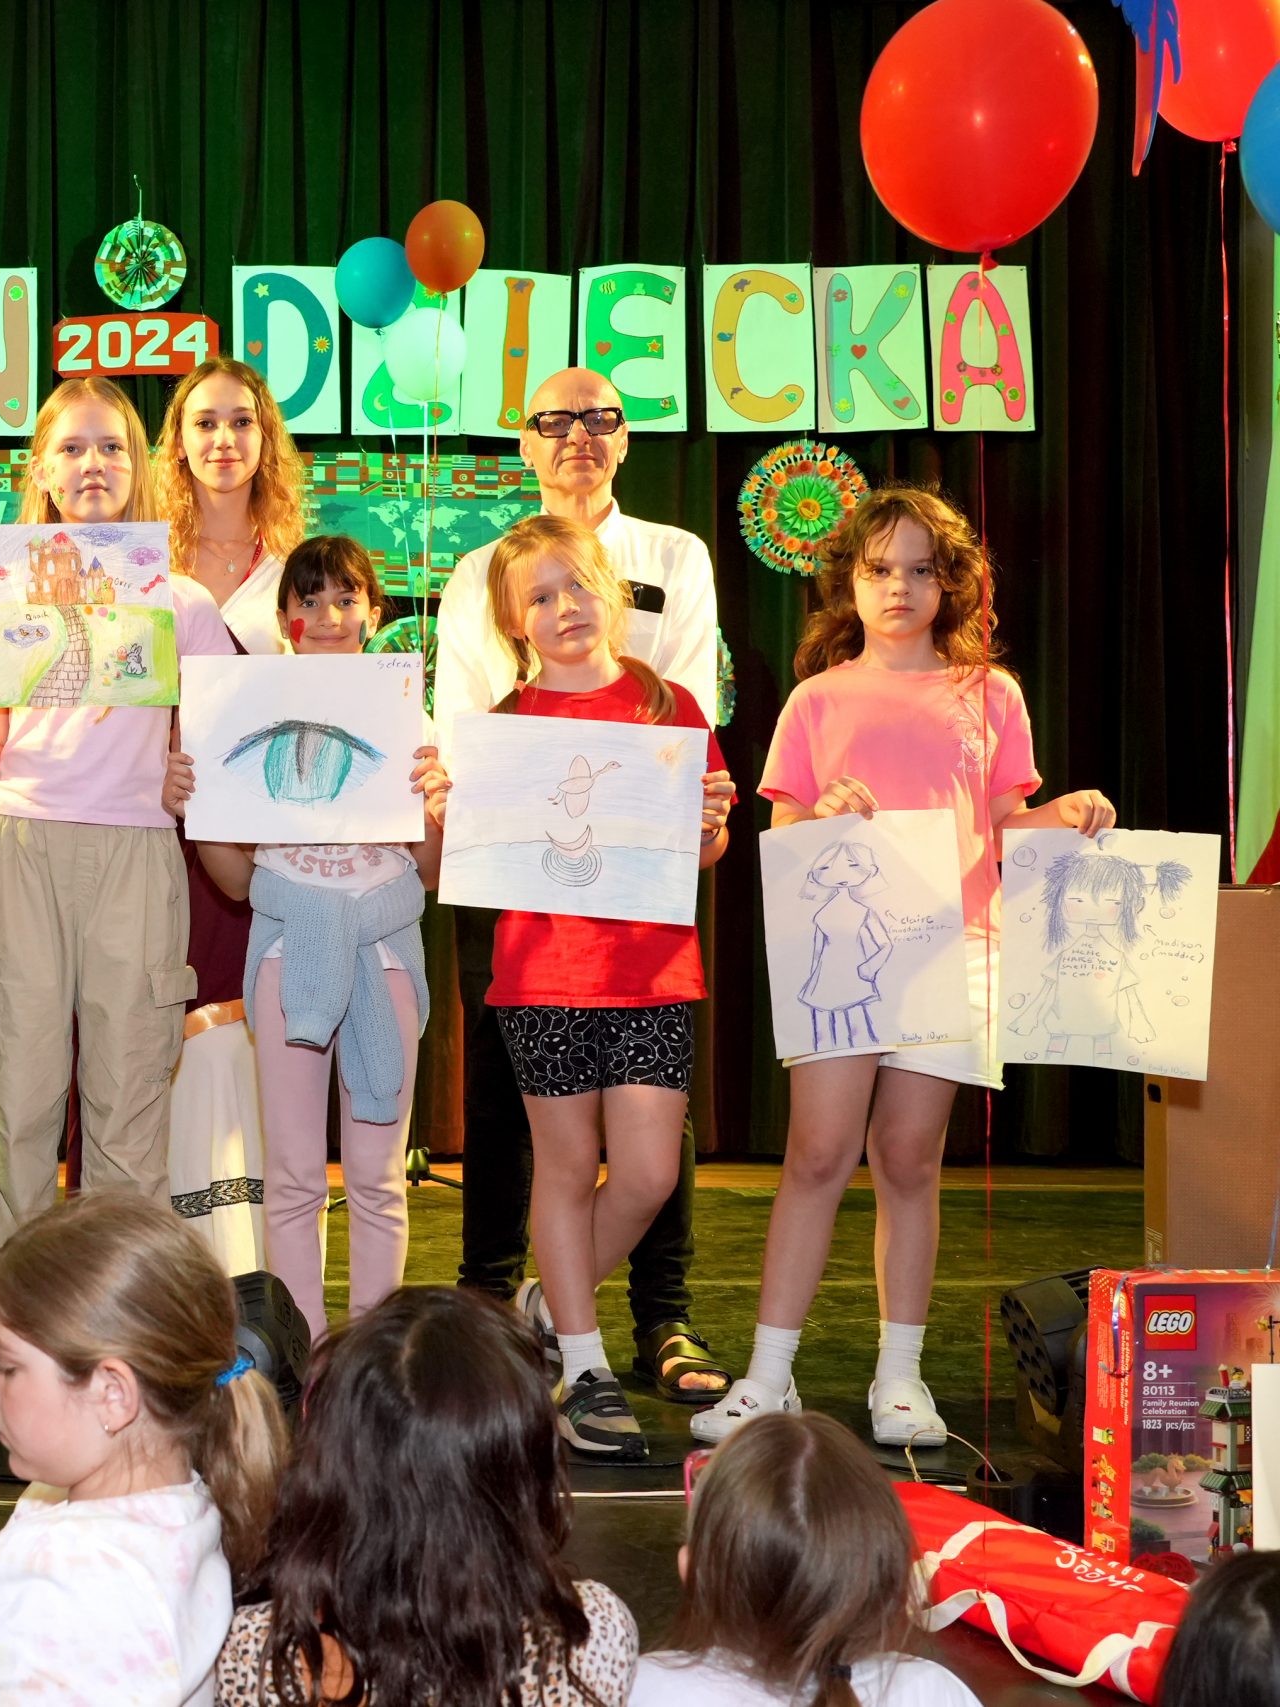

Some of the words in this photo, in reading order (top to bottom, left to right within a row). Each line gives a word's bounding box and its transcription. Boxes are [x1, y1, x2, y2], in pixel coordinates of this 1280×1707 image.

[58, 319, 209, 371] 2024
[284, 847, 356, 878] EASY
[1146, 1310, 1194, 1334] LEGO
[1142, 1361, 1173, 1381] 8+
[1142, 1386, 1175, 1396] 80113
[1142, 1400, 1167, 1410] Family
[1169, 1400, 1200, 1408] Reunion
[1142, 1408, 1187, 1416] Celebration
[1142, 1419, 1162, 1430] 1823
[1165, 1419, 1196, 1432] pcs/pzs
